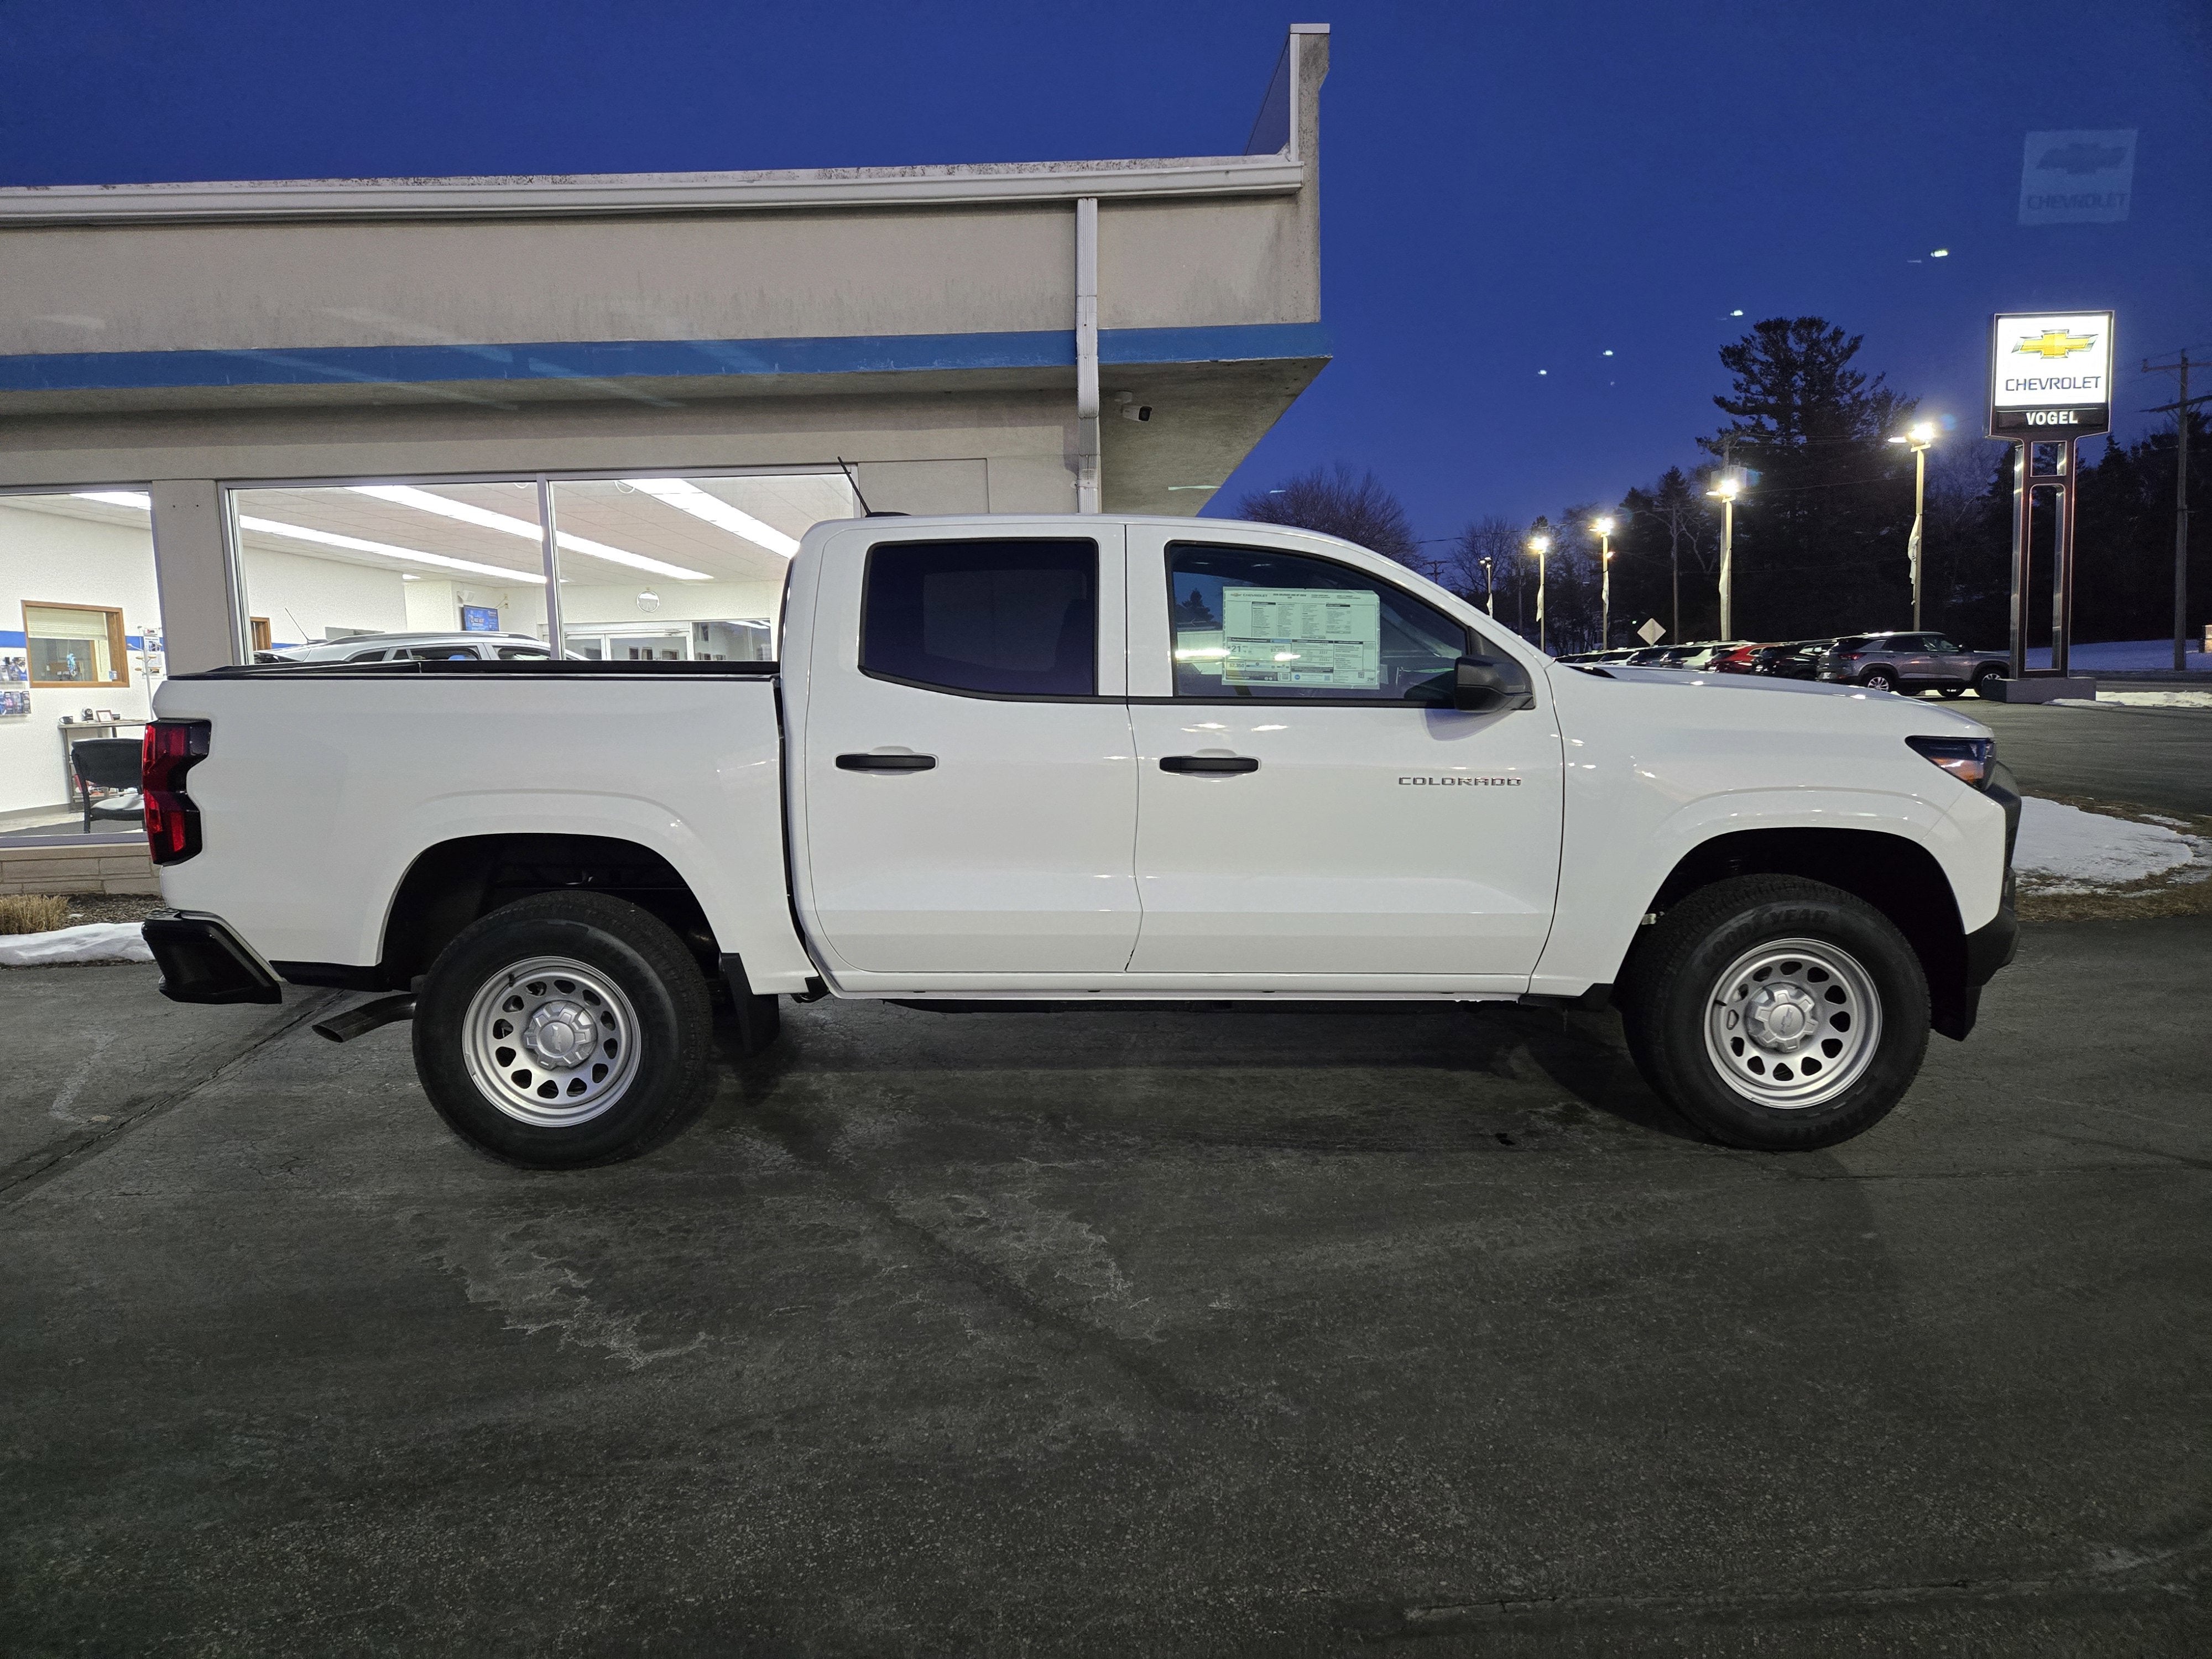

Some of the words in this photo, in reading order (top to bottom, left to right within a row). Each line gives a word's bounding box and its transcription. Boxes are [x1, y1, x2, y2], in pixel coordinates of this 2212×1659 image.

[2005, 376, 2101, 391] CHEVROLET
[2026, 411, 2078, 425] VOGEL
[1399, 777, 1521, 786] COLORADO
